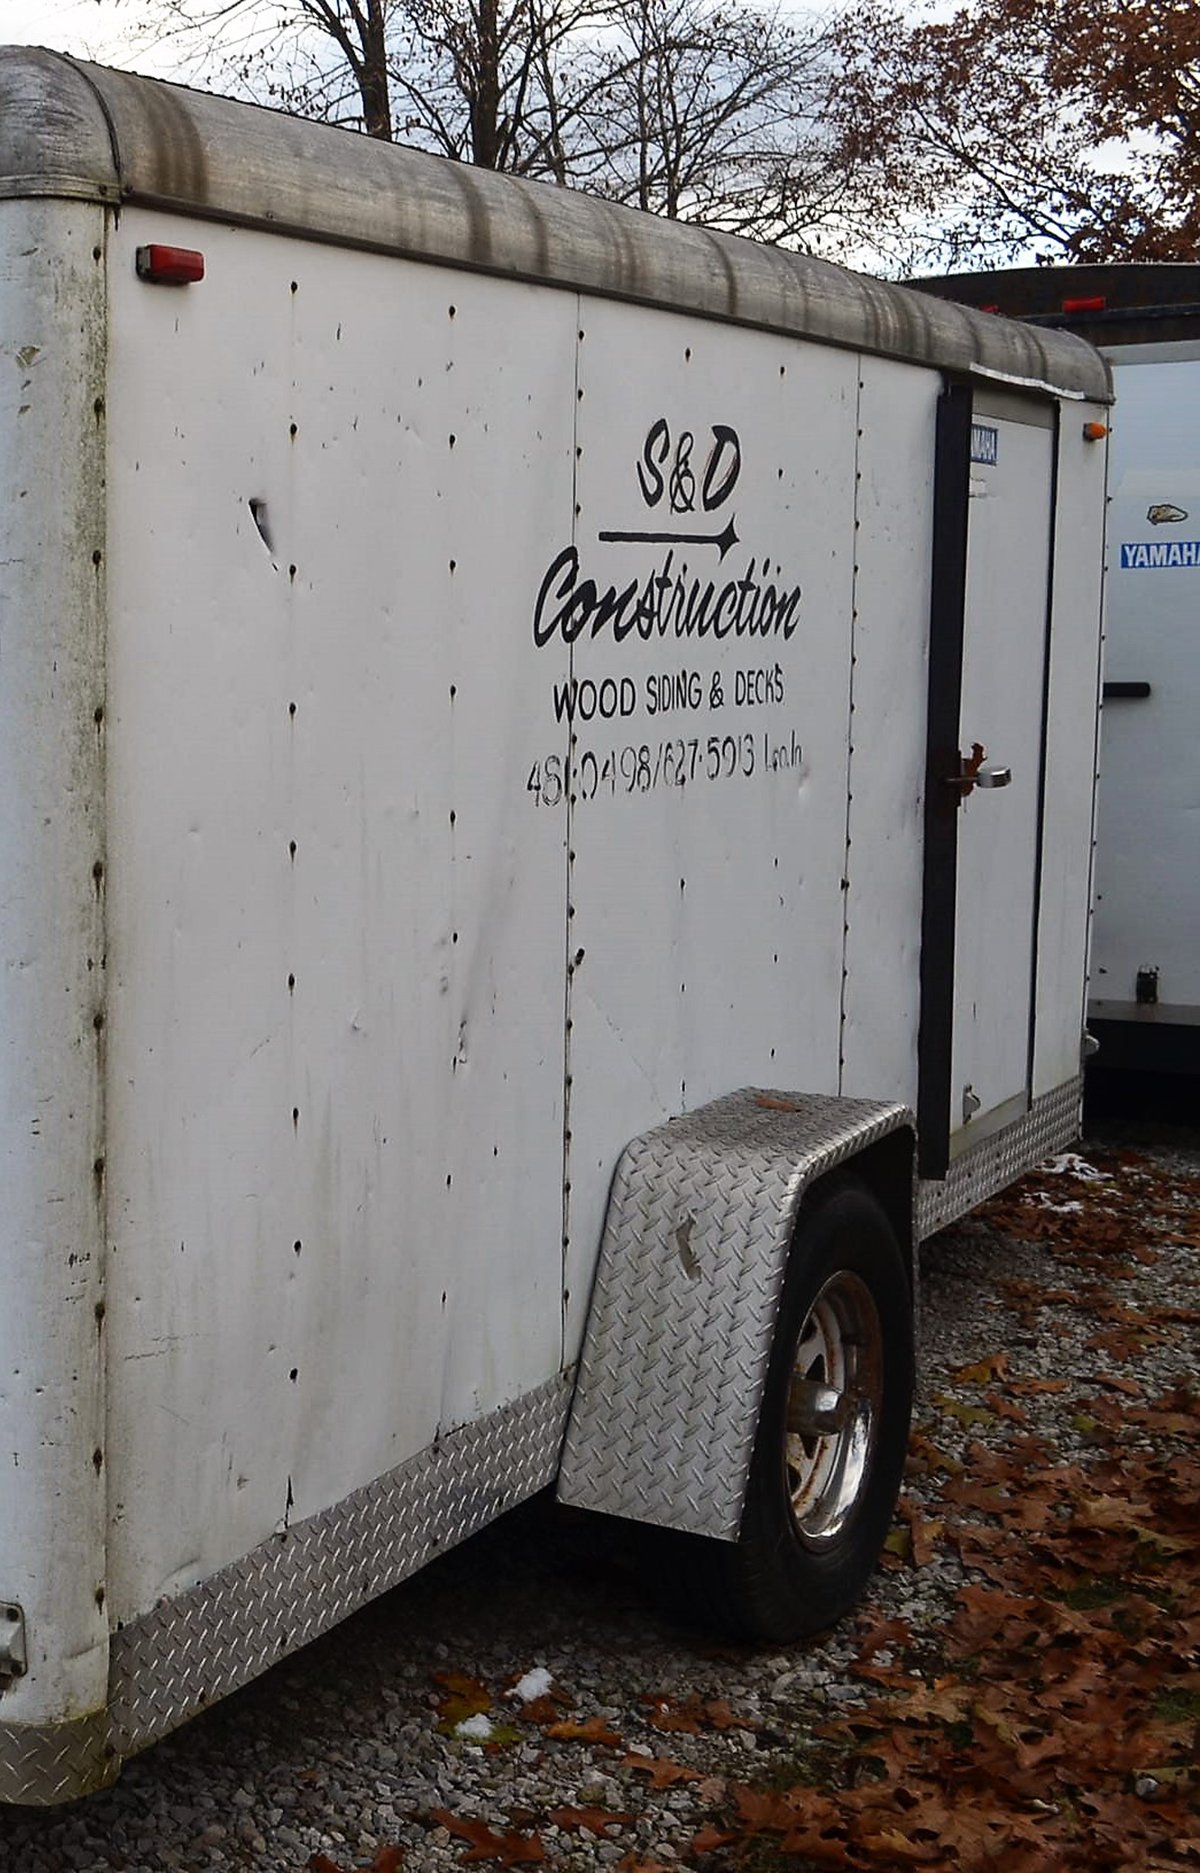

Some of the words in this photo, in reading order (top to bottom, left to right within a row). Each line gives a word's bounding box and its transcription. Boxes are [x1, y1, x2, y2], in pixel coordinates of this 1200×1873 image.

[1124, 544, 1200, 567] YAMAH
[533, 544, 801, 649] Construction
[553, 677, 636, 724] WOOD
[646, 669, 702, 716] SIDING
[709, 671, 725, 711] &
[734, 663, 784, 705] DECKS
